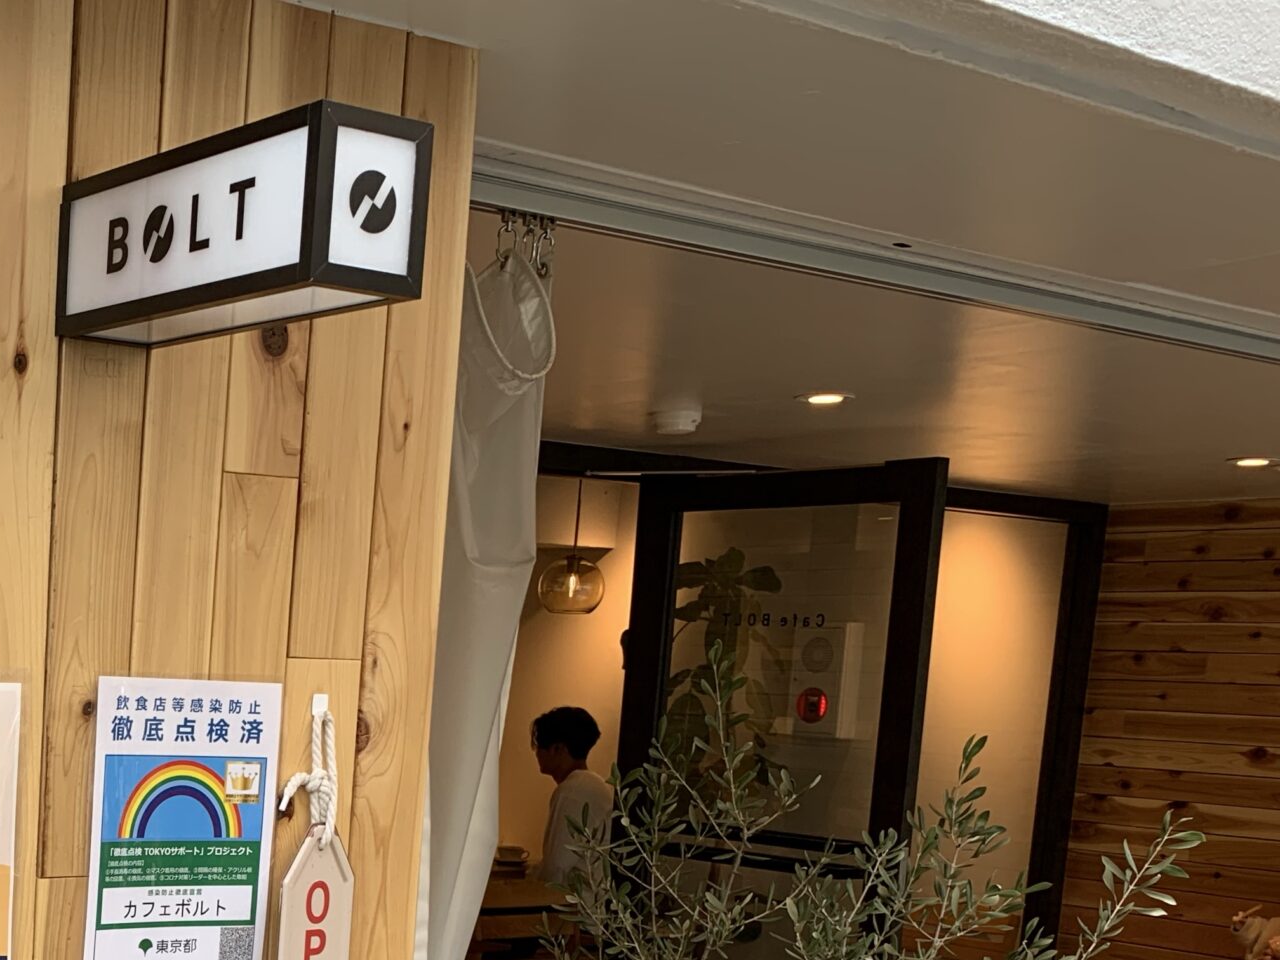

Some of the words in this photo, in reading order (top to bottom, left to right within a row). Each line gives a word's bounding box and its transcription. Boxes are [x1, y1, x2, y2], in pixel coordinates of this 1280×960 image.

[106, 176, 256, 275] BOLT
[116, 695, 261, 715] 飲食店等感染防止
[110, 715, 264, 745] 徹底点検済
[124, 898, 226, 919] カフェボルト
[156, 938, 197, 954] 東京都
